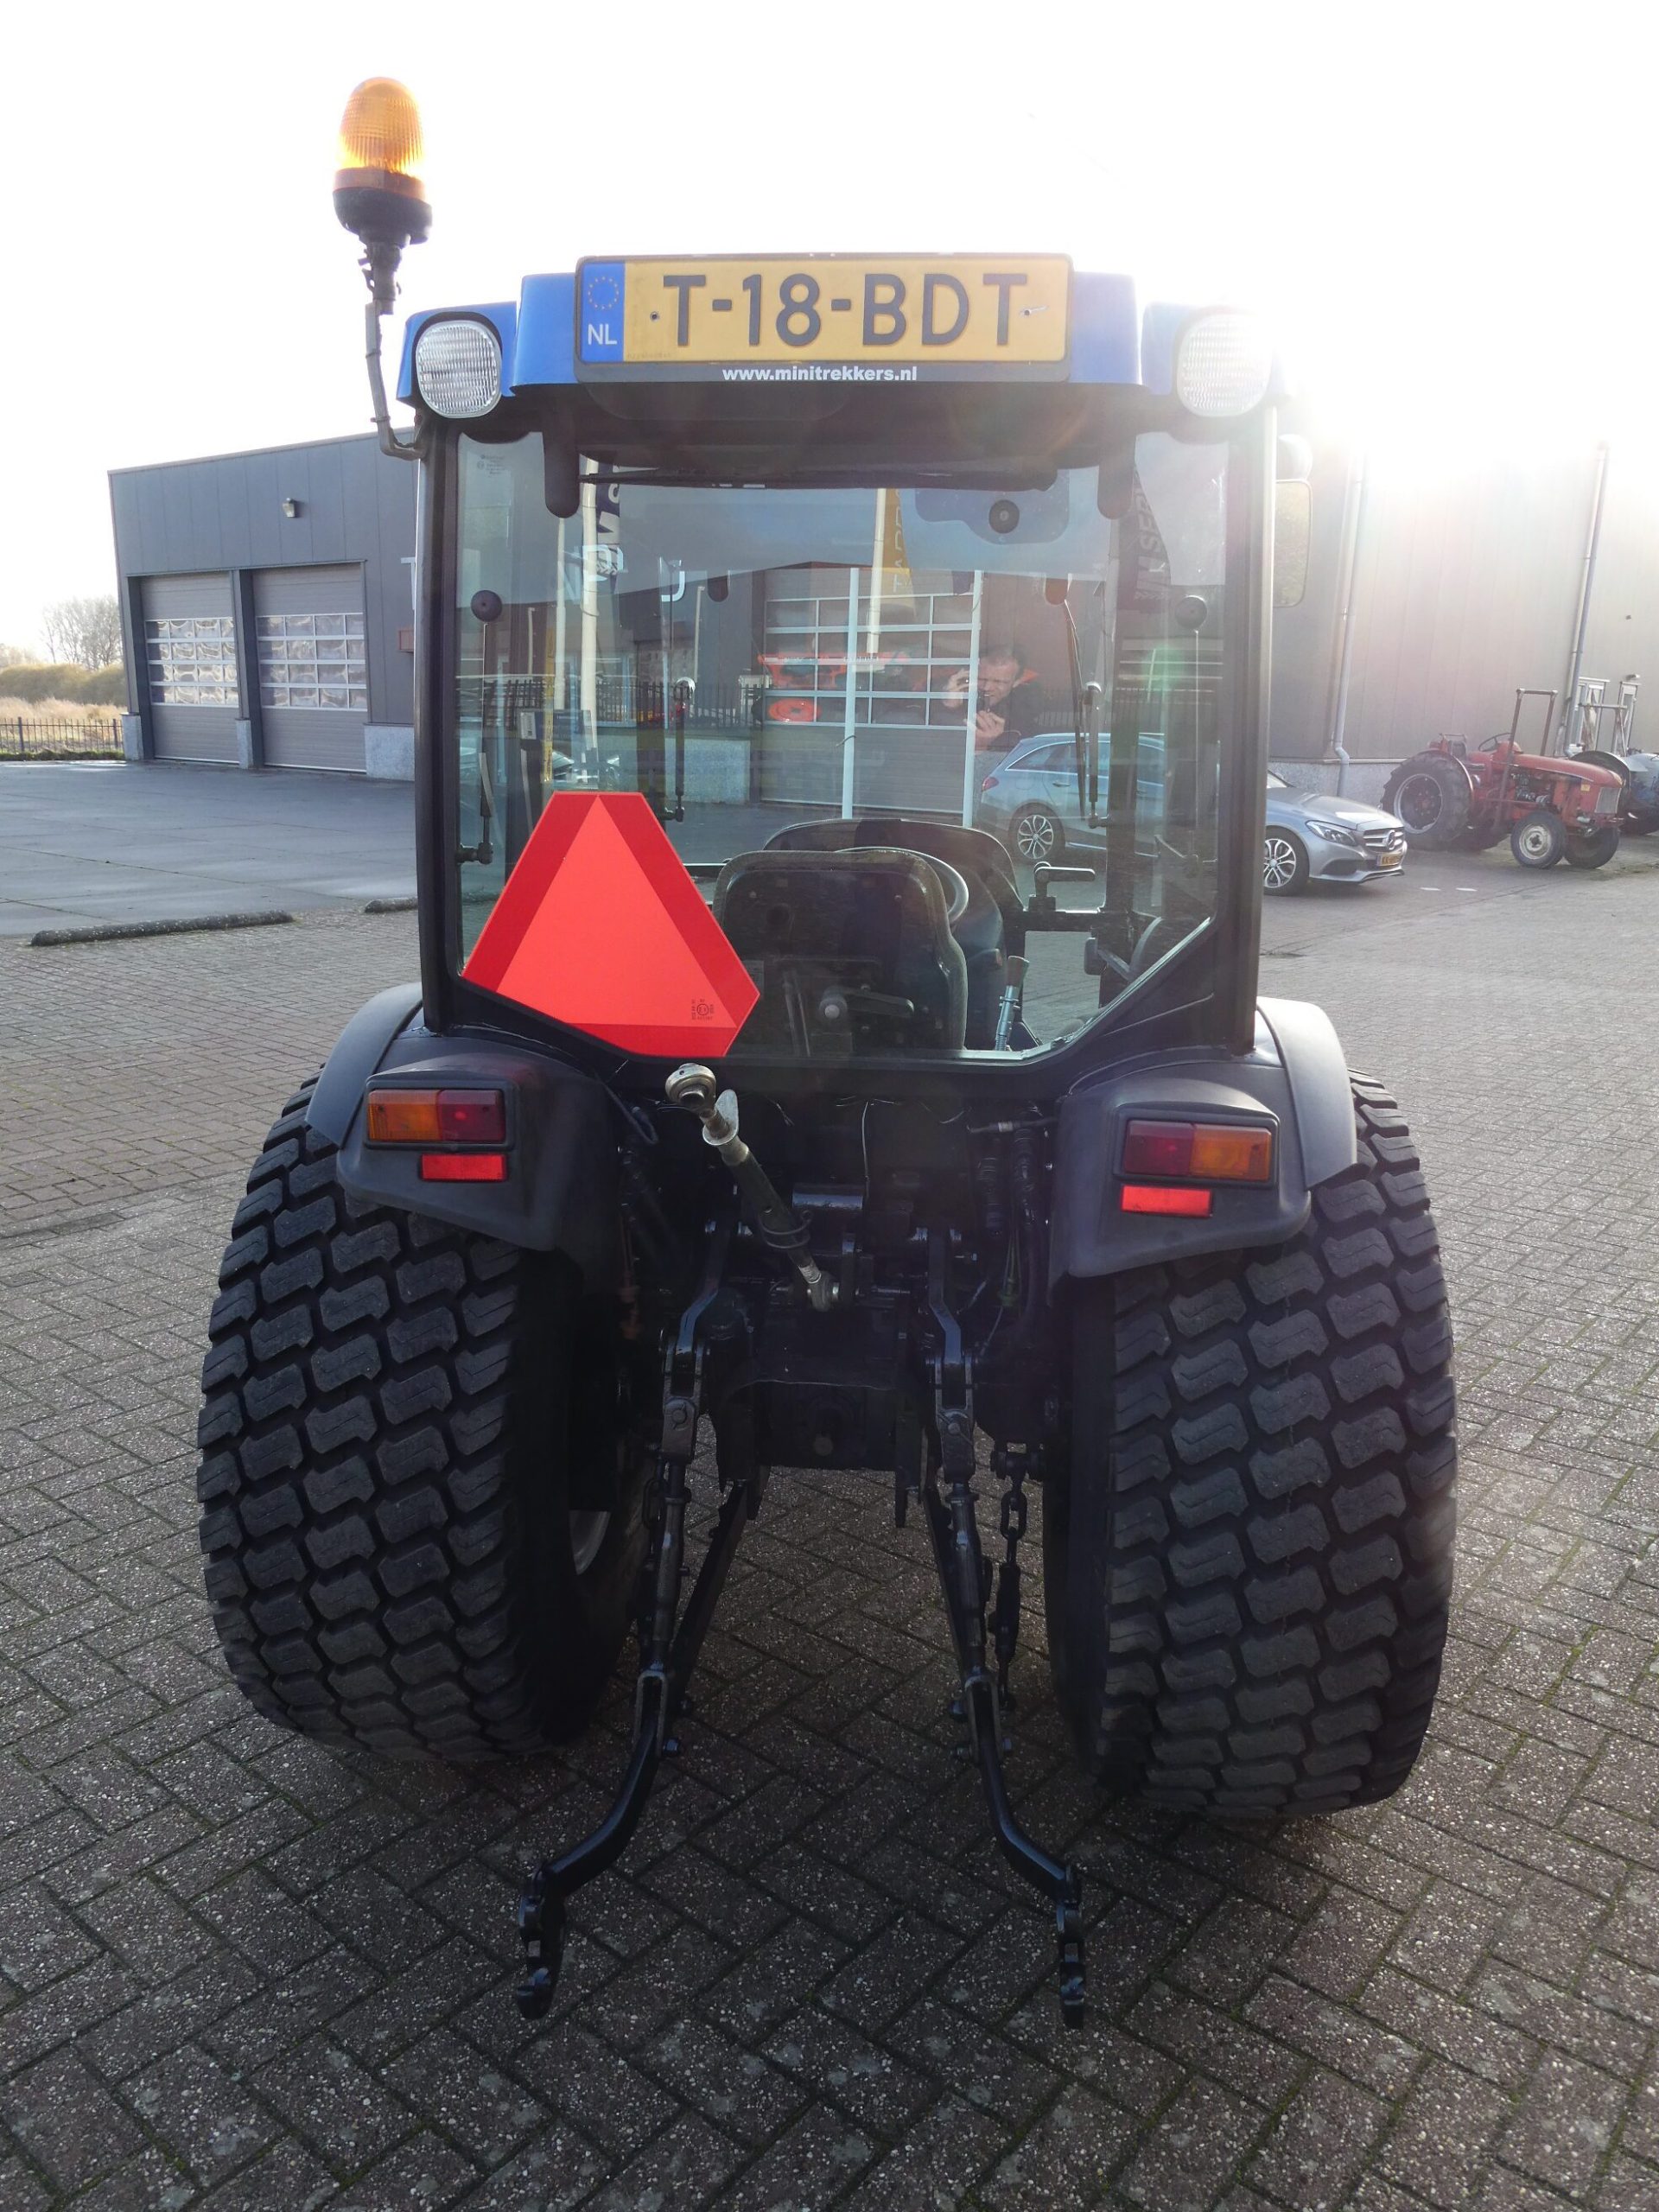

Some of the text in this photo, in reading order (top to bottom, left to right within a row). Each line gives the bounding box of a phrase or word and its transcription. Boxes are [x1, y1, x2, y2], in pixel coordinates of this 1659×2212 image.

[663, 273, 1028, 346] T-18-BDT
[588, 324, 617, 345] NL
[722, 365, 918, 381] www.minitrekkers.nl
